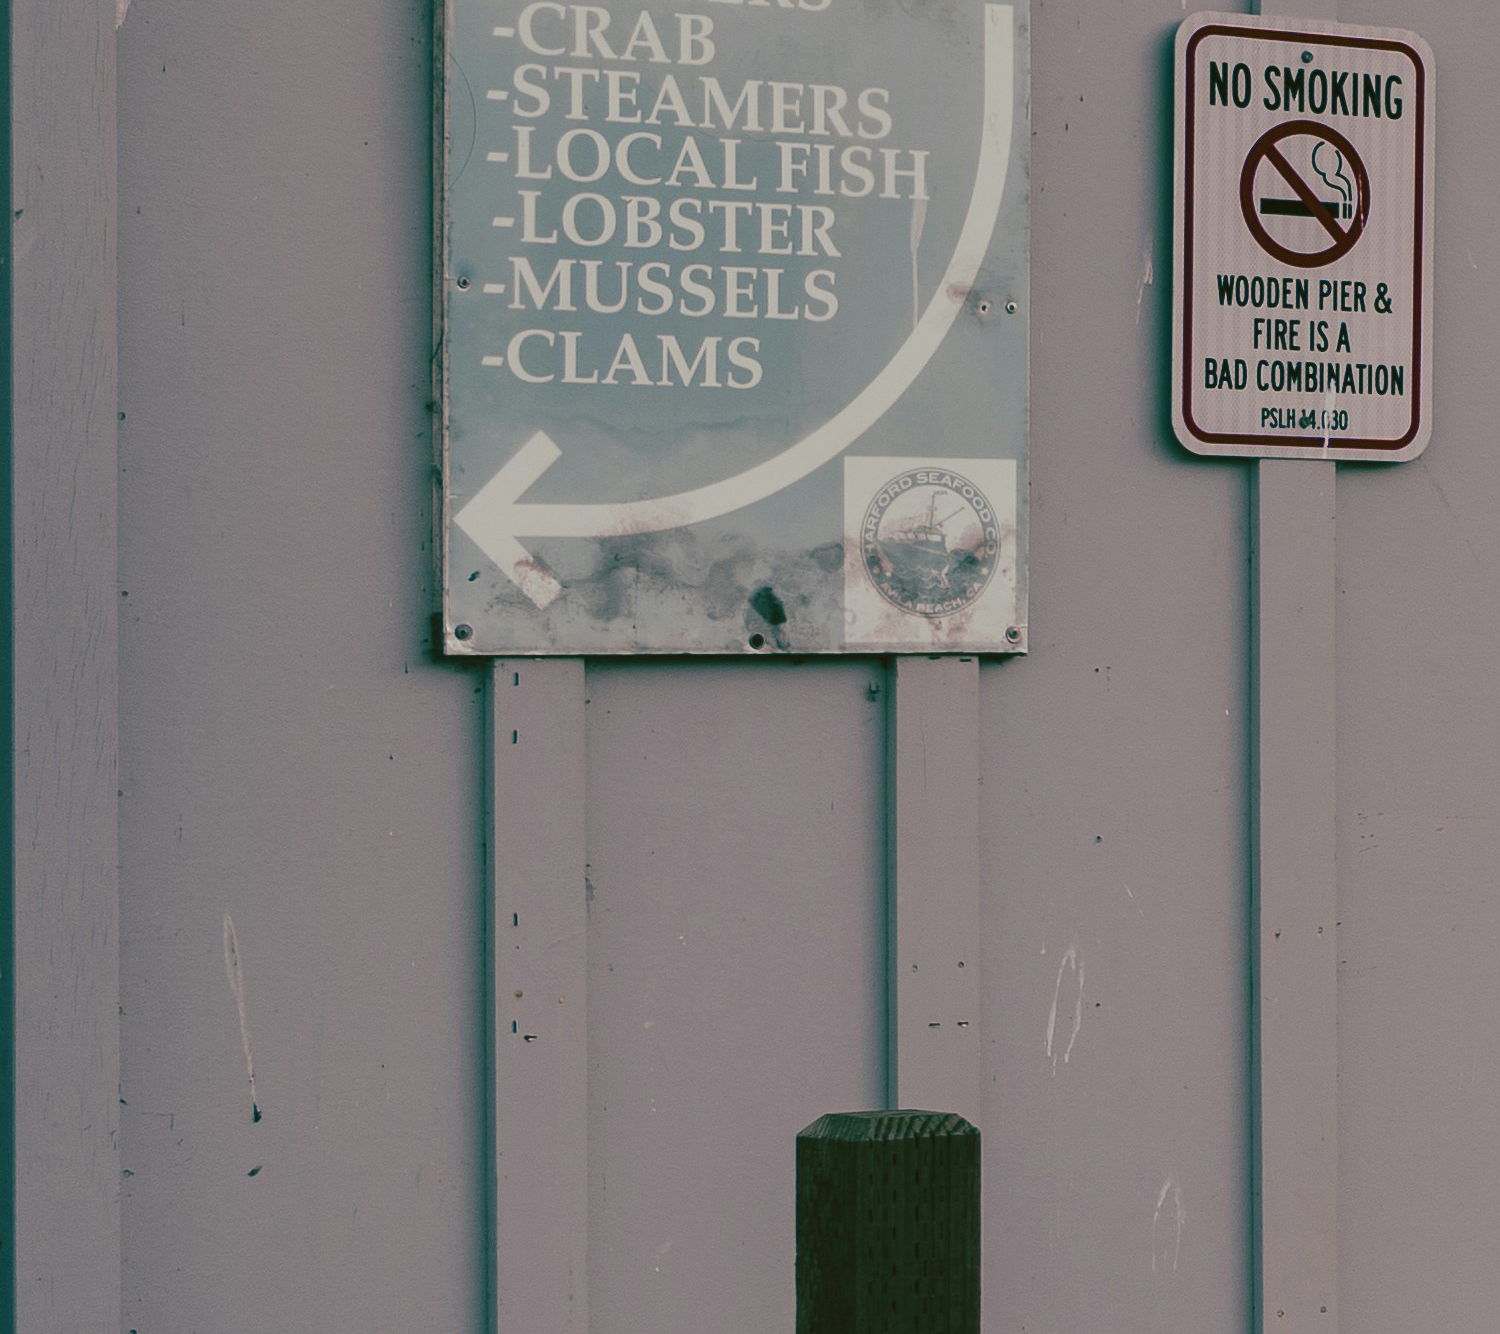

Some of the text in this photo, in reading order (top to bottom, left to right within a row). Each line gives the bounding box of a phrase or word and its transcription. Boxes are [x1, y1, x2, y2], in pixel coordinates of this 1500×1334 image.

[492, 2, 717, 66] -CRAB
[486, 63, 893, 140] -STEAMERS
[1208, 60, 1403, 120] NO SMOKING
[486, 124, 931, 201] -LOCAL FISH
[492, 189, 842, 259] -LOBSTER
[483, 257, 839, 322] -MUSSELS
[1216, 274, 1394, 315] WOODEN PIER &
[481, 328, 764, 390] -CLAMS
[1253, 318, 1352, 354] FIRE IS A
[1204, 357, 1405, 397] BAD COMBINATION
[1261, 407, 1296, 429] PSLH
[916, 471, 992, 524] SEAFOOD
